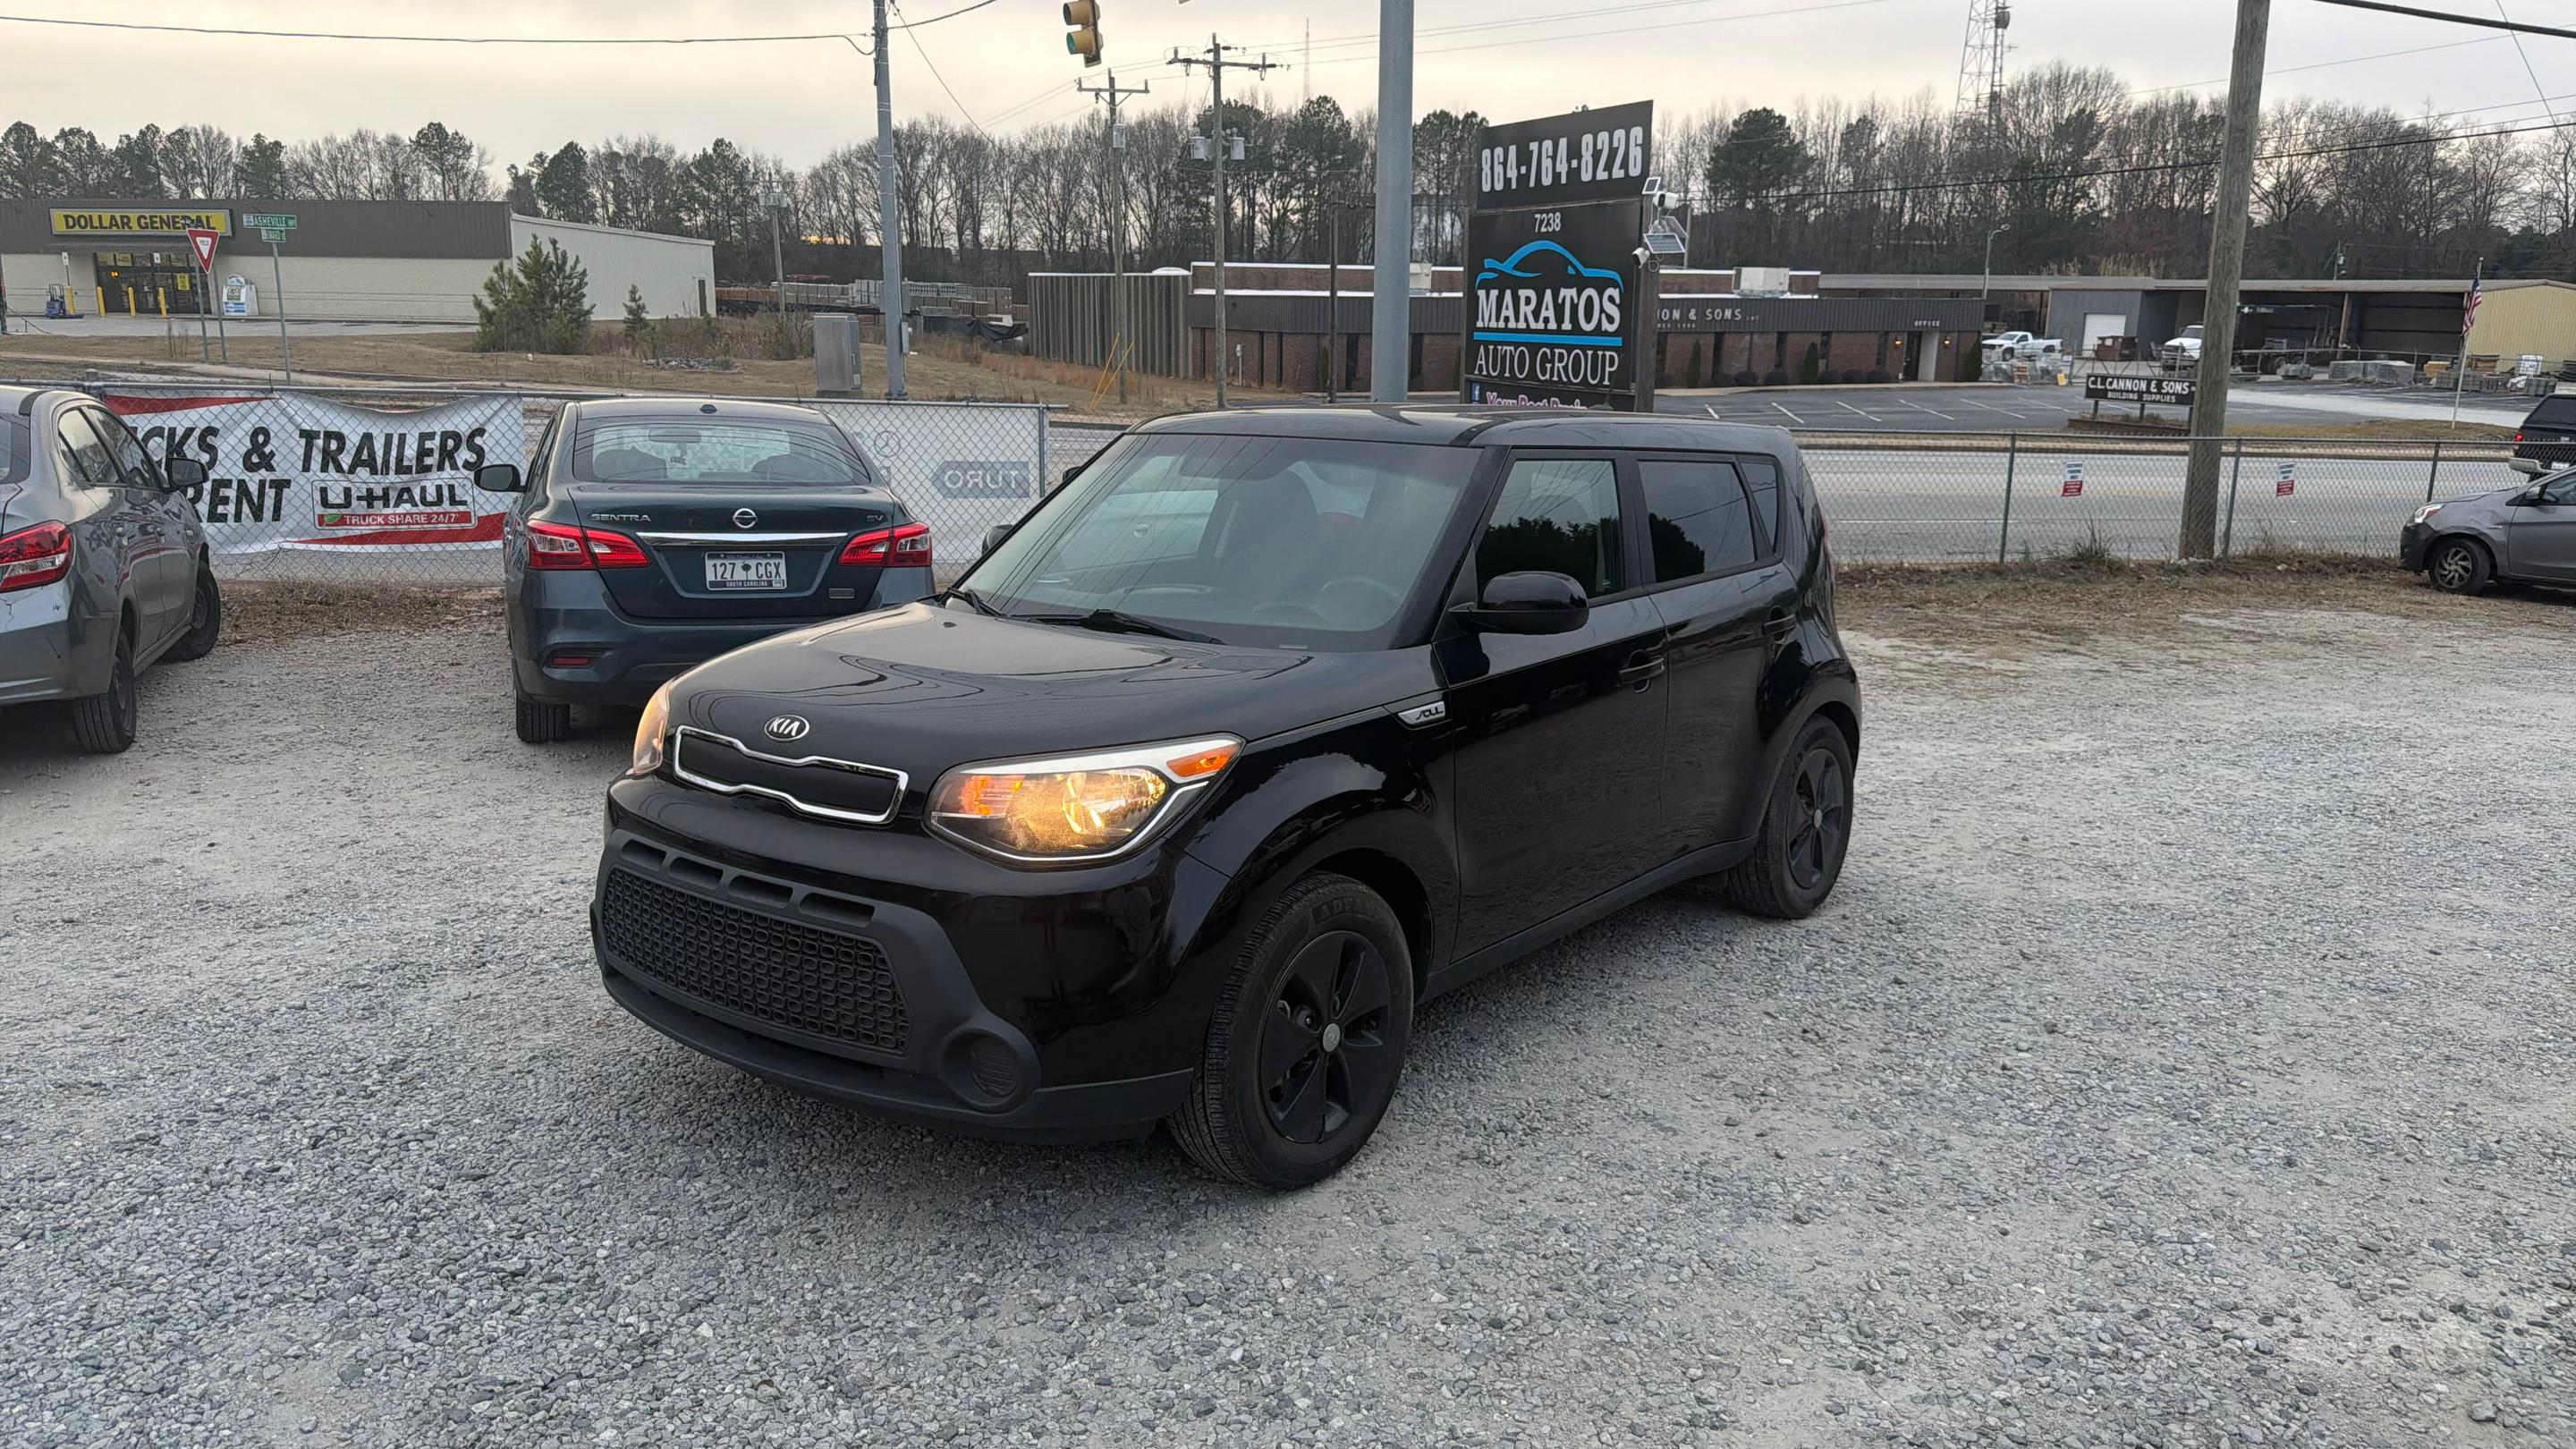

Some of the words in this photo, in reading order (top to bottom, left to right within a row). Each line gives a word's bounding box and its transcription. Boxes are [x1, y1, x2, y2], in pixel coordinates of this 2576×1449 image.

[1481, 125, 1644, 193] 864-764-8226
[63, 214, 133, 230] DOLLAR
[136, 214, 216, 231] GENERAL
[254, 216, 286, 227] ASHEVILLE
[1534, 211, 1562, 233] 7238
[1476, 286, 1621, 333] MARATOS
[1688, 308, 1697, 320] &
[1705, 308, 1741, 320] SONS
[1473, 343, 1530, 378] AUTO
[1536, 347, 1619, 386] GROUP
[2149, 380, 2157, 393] &
[2161, 381, 2190, 394] SONS
[2107, 392, 2139, 400] BUILDING
[2142, 394, 2176, 402] SUPPLIES
[130, 426, 220, 471] CKS
[242, 426, 277, 473] &
[299, 427, 487, 476] TRAILERS
[318, 484, 468, 509] U-HAUL
[343, 513, 385, 525] TRUCK
[387, 513, 428, 524] SHARE
[430, 513, 456, 523] 24/7
[590, 513, 652, 522] SENTRA
[866, 514, 885, 522] SV
[711, 563, 736, 580] 127
[755, 562, 782, 579] CGX
[768, 717, 801, 736] KIA
